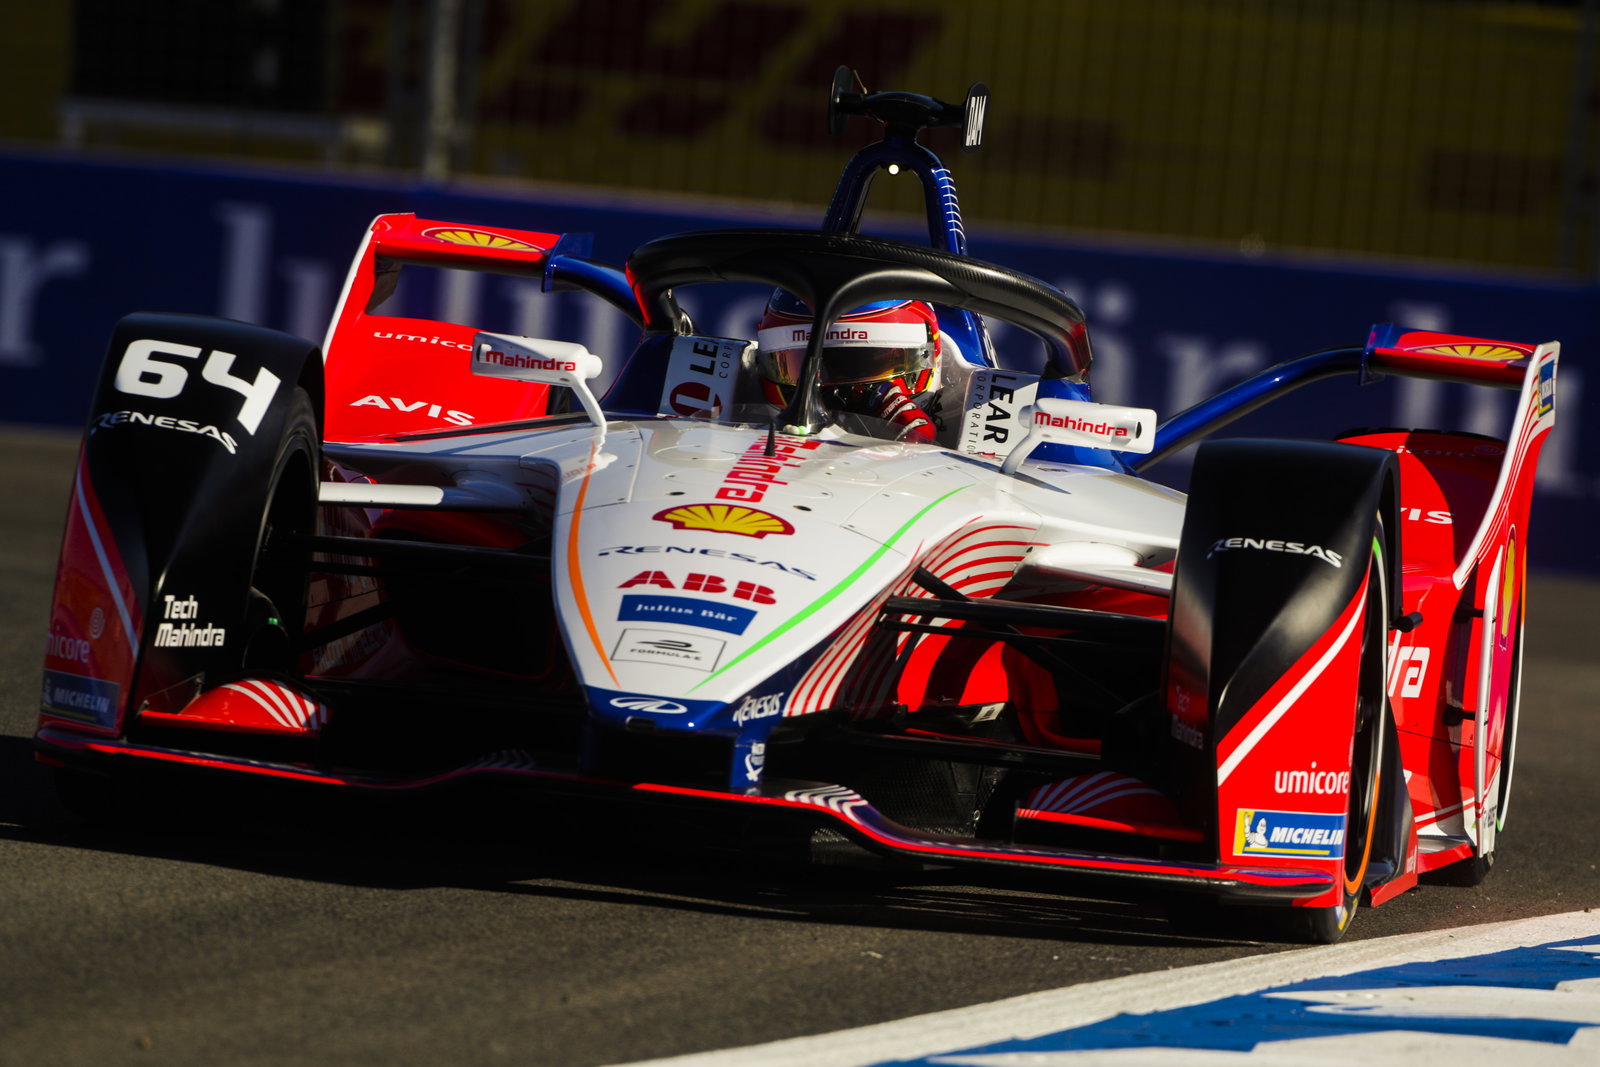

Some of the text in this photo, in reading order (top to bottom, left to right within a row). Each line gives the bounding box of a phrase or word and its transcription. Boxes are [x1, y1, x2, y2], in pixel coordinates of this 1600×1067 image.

[373, 331, 473, 352] umico
[792, 328, 868, 342] Maindra
[485, 350, 577, 372] Mahindra
[113, 339, 282, 437] 64
[350, 395, 475, 426] AVIS
[983, 374, 1017, 444] LEAR
[1034, 411, 1128, 437] Mahindra
[598, 545, 816, 581] RENESAS
[1206, 537, 1342, 568] RENESAS
[616, 570, 777, 605] ABB
[163, 594, 198, 620] Tech
[635, 603, 694, 615] Julius
[153, 622, 226, 648] Mahindra
[53, 687, 111, 713] MICHELIN
[1269, 826, 1345, 846] MICHELIN
